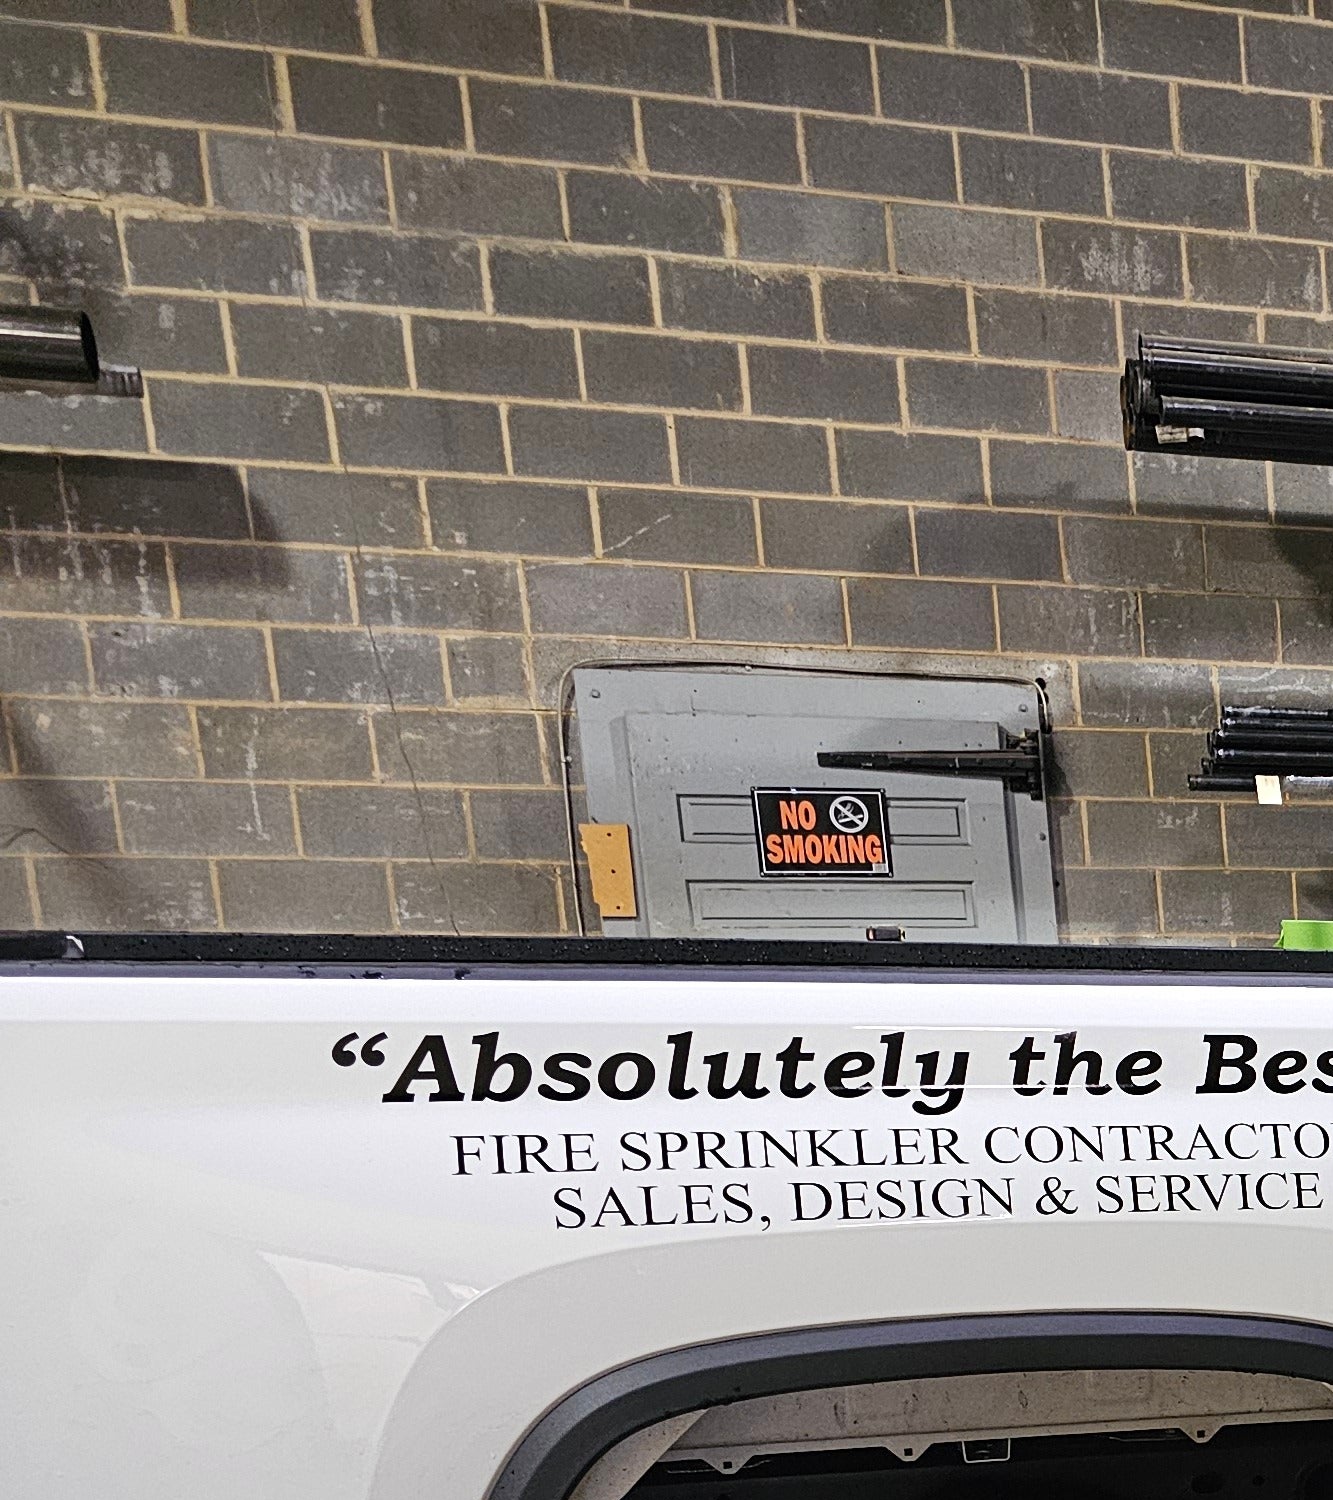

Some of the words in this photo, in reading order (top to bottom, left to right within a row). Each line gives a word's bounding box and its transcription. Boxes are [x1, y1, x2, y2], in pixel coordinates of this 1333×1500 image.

[778, 800, 817, 831] NO
[765, 833, 883, 865] SMOKING
[1008, 1030, 1163, 1097] the
[450, 1133, 599, 1176] FIRE
[619, 1127, 969, 1172] SPRINKLER
[553, 1183, 772, 1232] SALES,
[788, 1177, 1015, 1222] DESIGN
[1035, 1176, 1079, 1216] &
[1095, 1172, 1324, 1214] SERVICE
